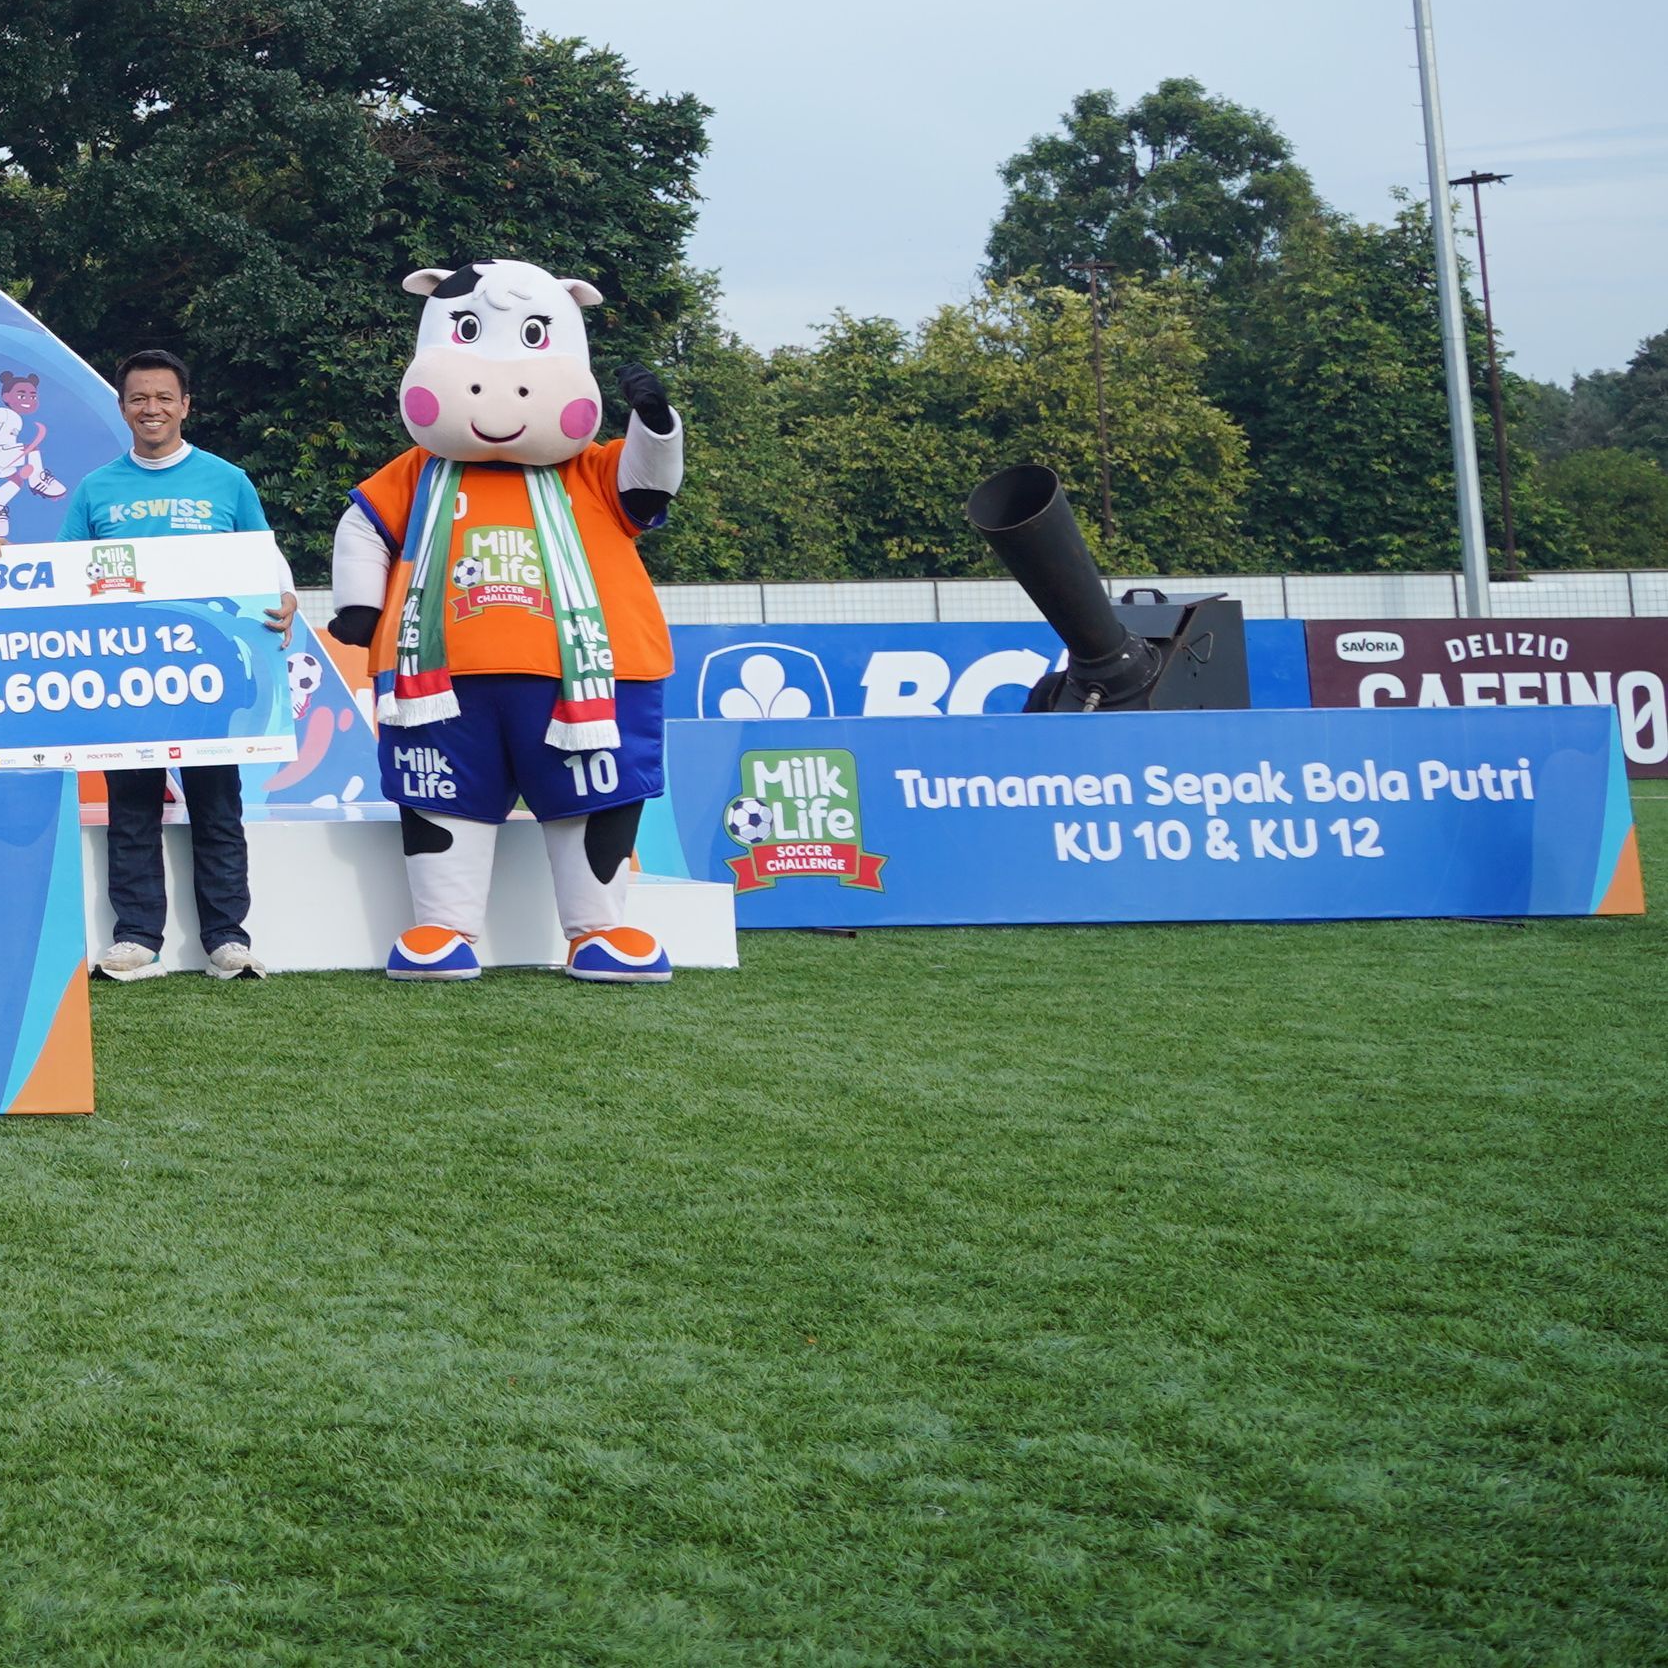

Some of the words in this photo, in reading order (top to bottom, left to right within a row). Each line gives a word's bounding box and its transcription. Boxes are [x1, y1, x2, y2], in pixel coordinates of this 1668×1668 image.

[96, 545, 132, 563] Milk
[471, 529, 538, 560] Milk
[103, 562, 135, 578] Life
[482, 556, 542, 586] Life
[476, 592, 534, 605] CHALLENGE
[484, 585, 525, 595] SOCCER
[98, 626, 146, 657] KU
[154, 623, 196, 653] 12
[1341, 638, 1400, 654] SAVORIA
[1443, 631, 1570, 664] DELIZIO
[860, 648, 1068, 717] BC
[393, 746, 454, 775] Milk
[563, 751, 619, 796] 10
[403, 772, 457, 799] Life
[752, 755, 850, 800] Milk
[894, 768, 1134, 809] Turnamen
[1144, 760, 1294, 817] Sepak
[1302, 759, 1411, 804] Bola
[1418, 757, 1535, 802] Putri
[772, 797, 856, 841] Life
[776, 844, 833, 858] SOCCER
[1053, 821, 1122, 864] KU
[1131, 819, 1192, 863] 10
[1205, 819, 1240, 864] &
[1250, 818, 1318, 862] KU
[1328, 817, 1385, 858] 12
[766, 856, 847, 873] CHALLENGE
